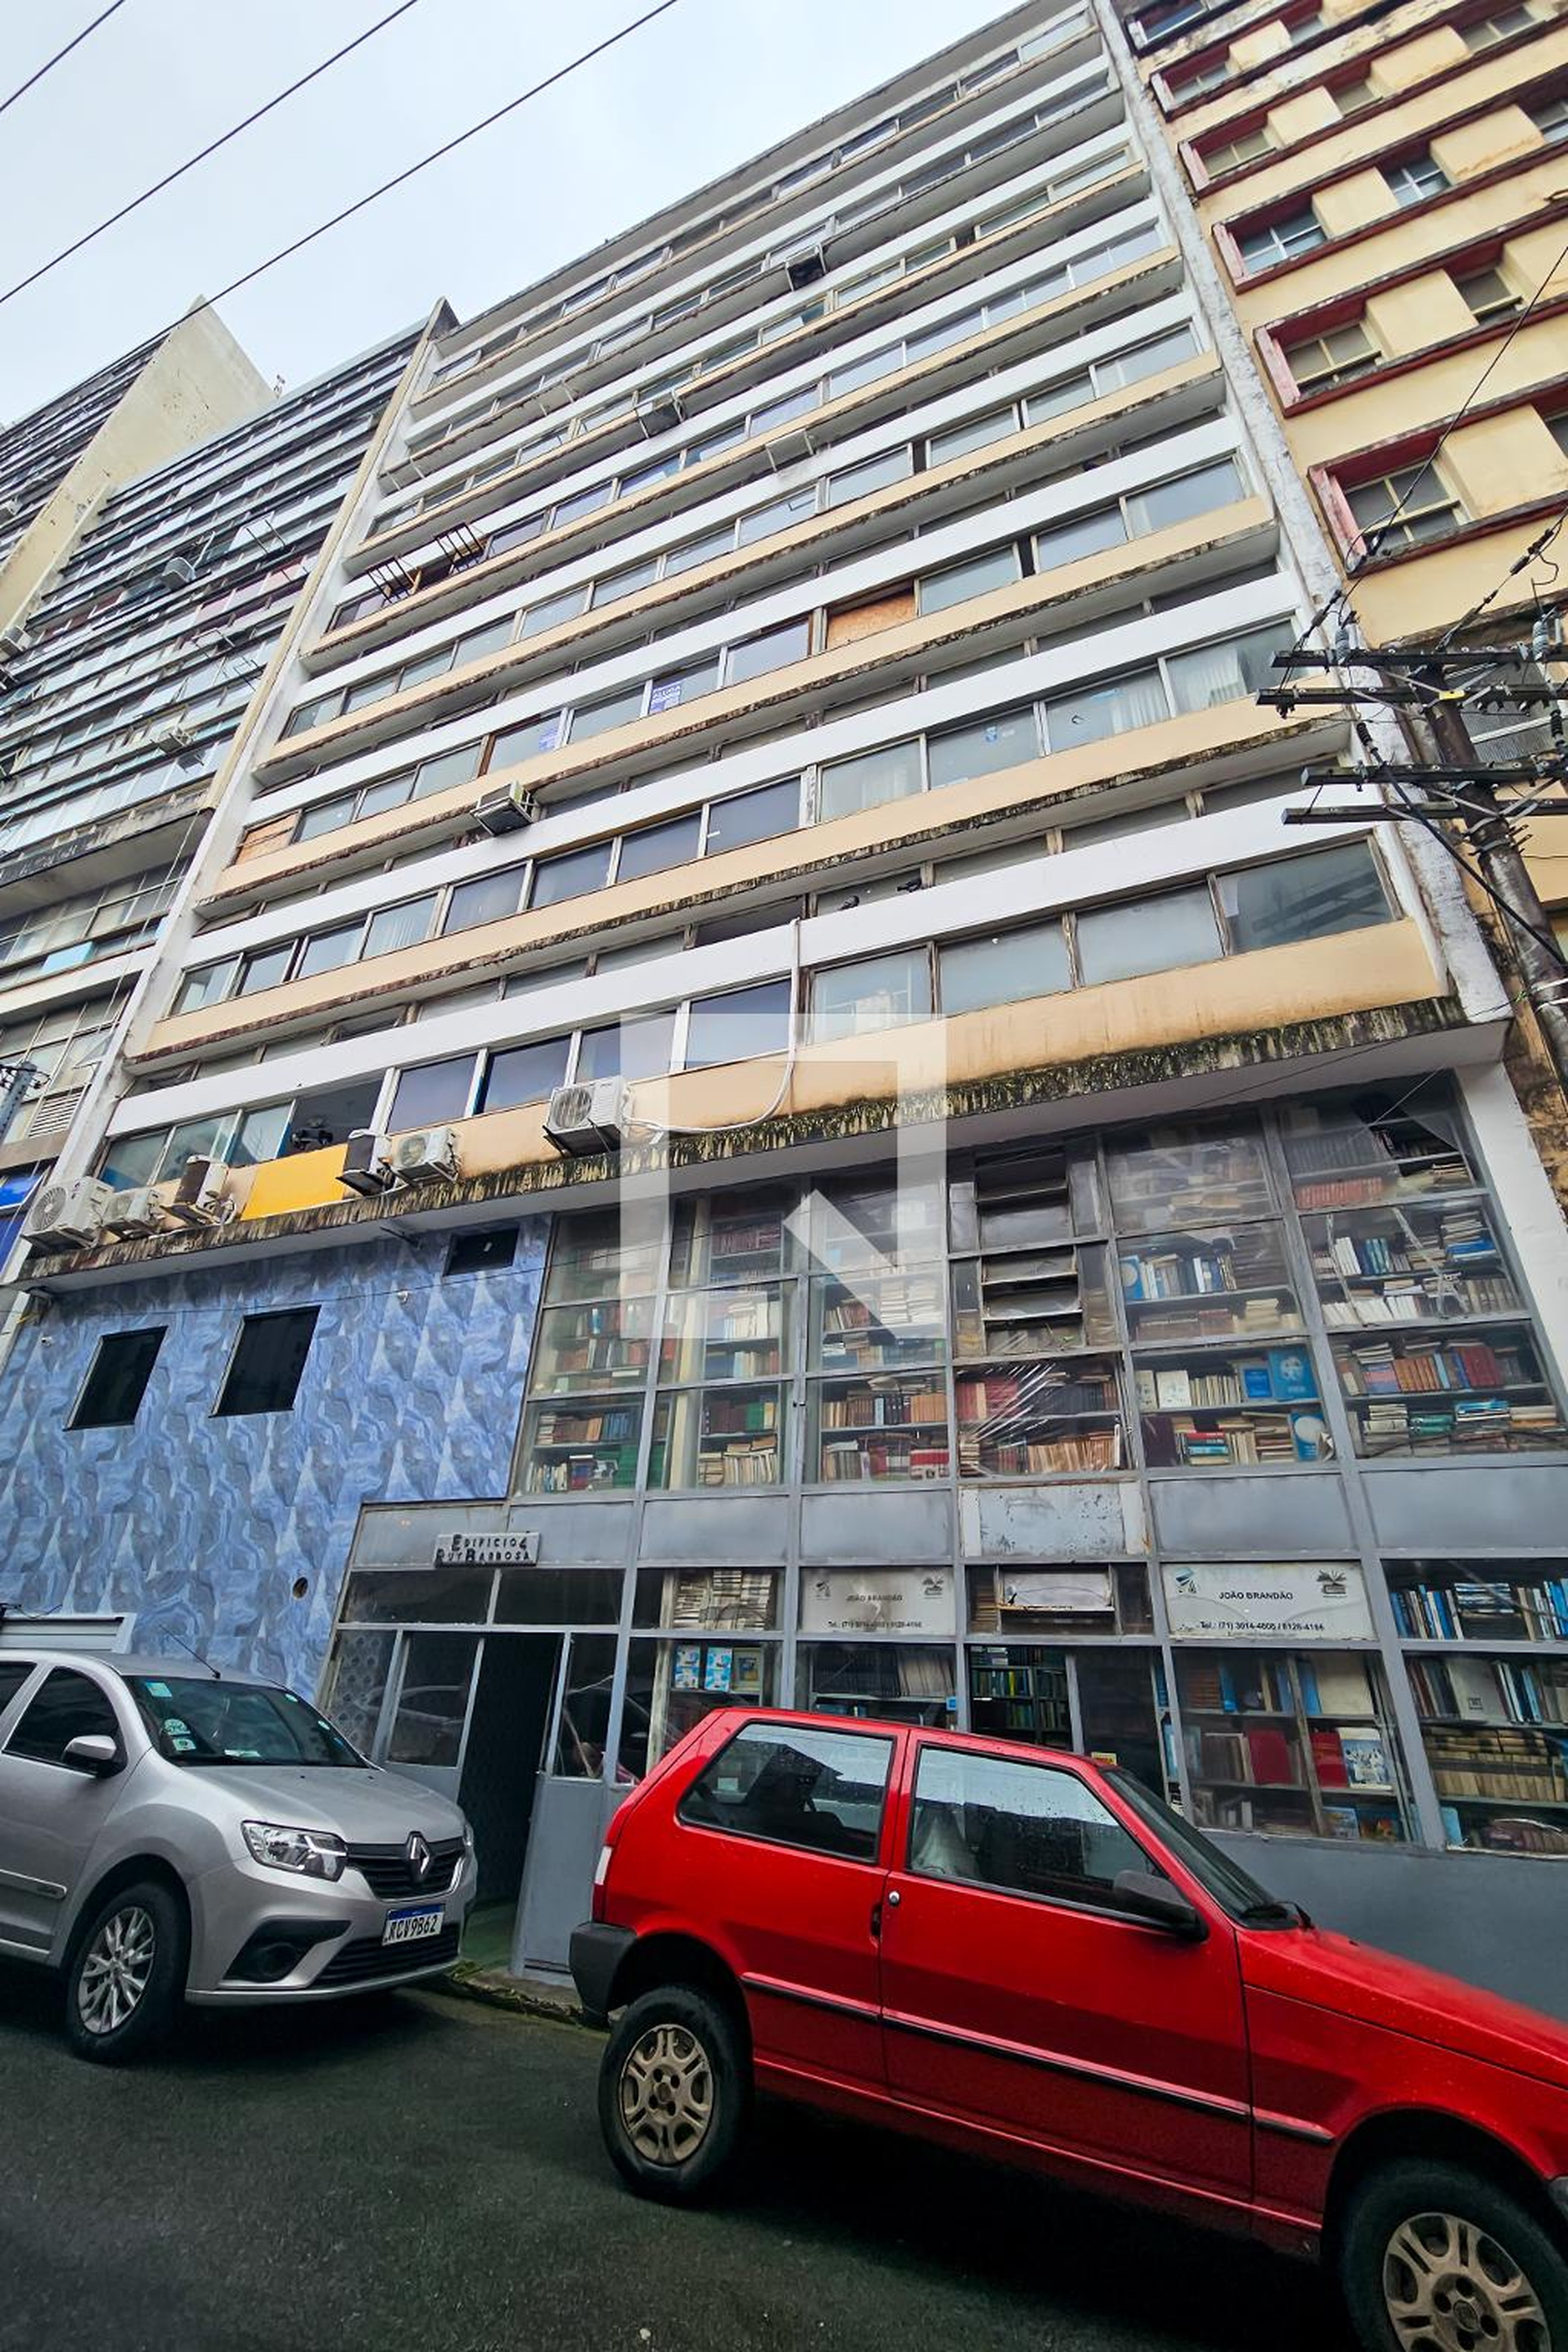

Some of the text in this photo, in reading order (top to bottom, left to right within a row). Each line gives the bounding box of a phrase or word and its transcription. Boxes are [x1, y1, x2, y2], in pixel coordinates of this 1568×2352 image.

[466, 1548, 530, 1562] BARBOSA
[1219, 1590, 1293, 1600] JOÃO BRANDÃO
